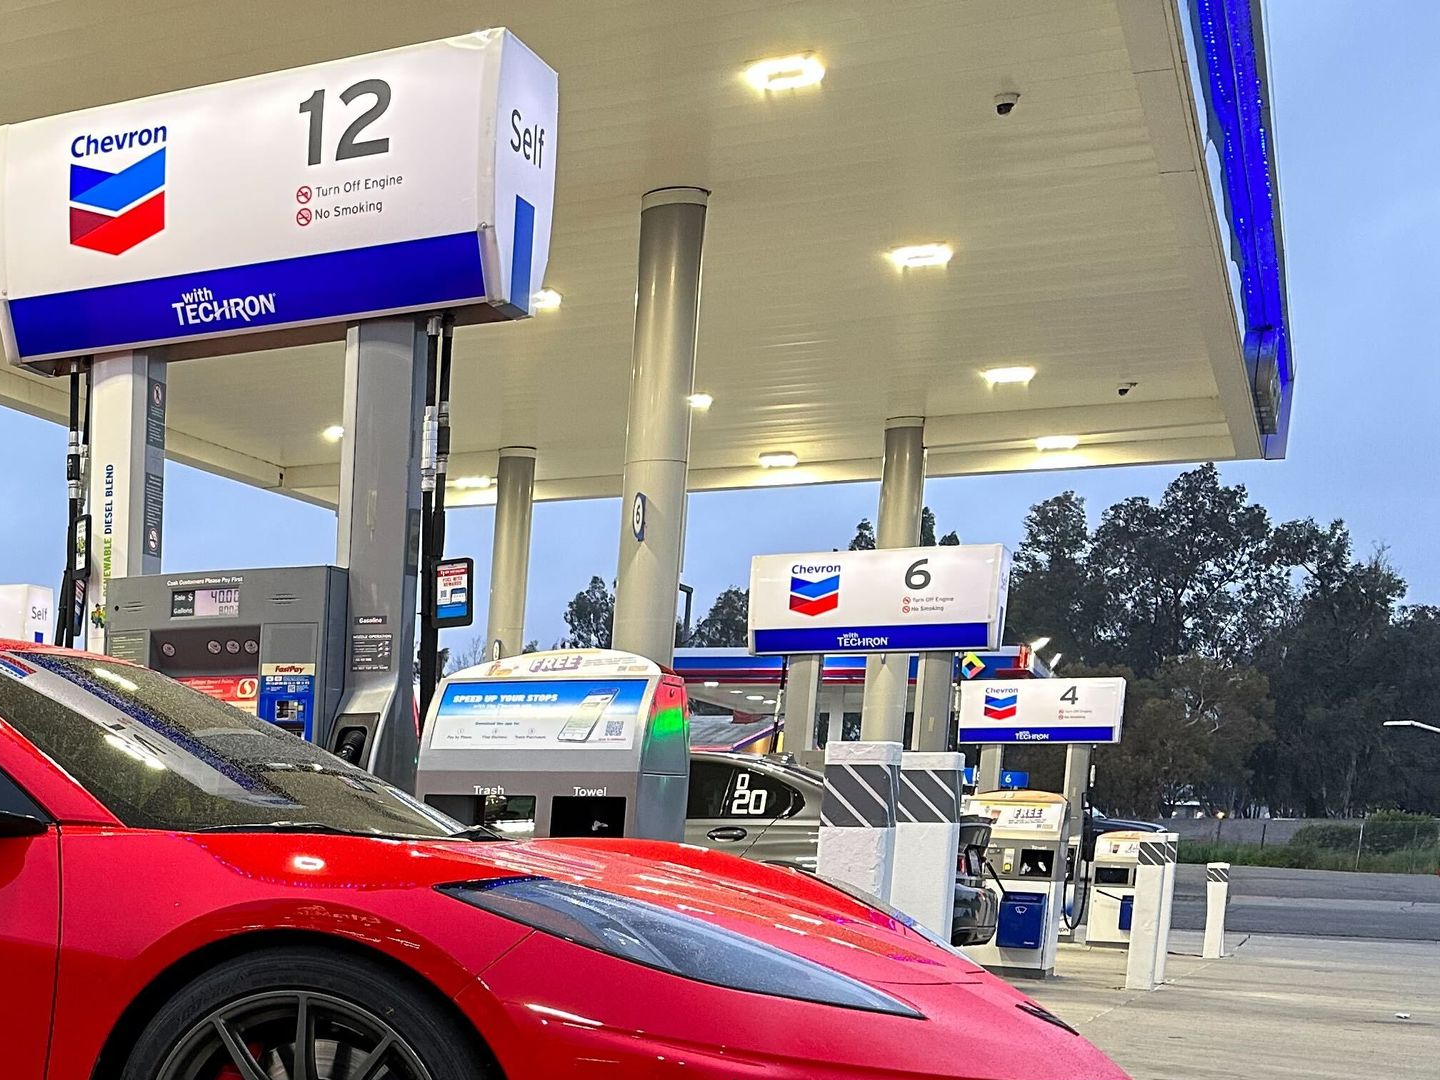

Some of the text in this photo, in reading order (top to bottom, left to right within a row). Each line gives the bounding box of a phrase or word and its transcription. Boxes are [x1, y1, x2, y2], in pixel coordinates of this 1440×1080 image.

[299, 78, 392, 167] 12
[71, 124, 168, 159] Chevron
[509, 108, 546, 170] Self
[315, 174, 403, 198] Turn Off Engine
[314, 201, 383, 221] No Smoking
[181, 287, 214, 304] with
[171, 293, 276, 326] TECHRON
[105, 464, 114, 498] BLEND
[104, 500, 113, 535] DIESEL
[636, 504, 641, 525] 6
[791, 563, 842, 575] Chevron
[904, 558, 932, 590] 6
[31, 606, 48, 621] Self
[836, 636, 888, 648] TECHRON
[274, 665, 305, 674] FastPay
[529, 655, 583, 673] FREE
[452, 694, 559, 703] SPEED UP YOUR STOPS
[1059, 685, 1079, 705] 4
[1005, 774, 1012, 783] 6
[473, 785, 505, 795] Trash
[573, 786, 607, 797] Towel
[731, 789, 768, 814] 20
[1013, 808, 1043, 819] FREE
